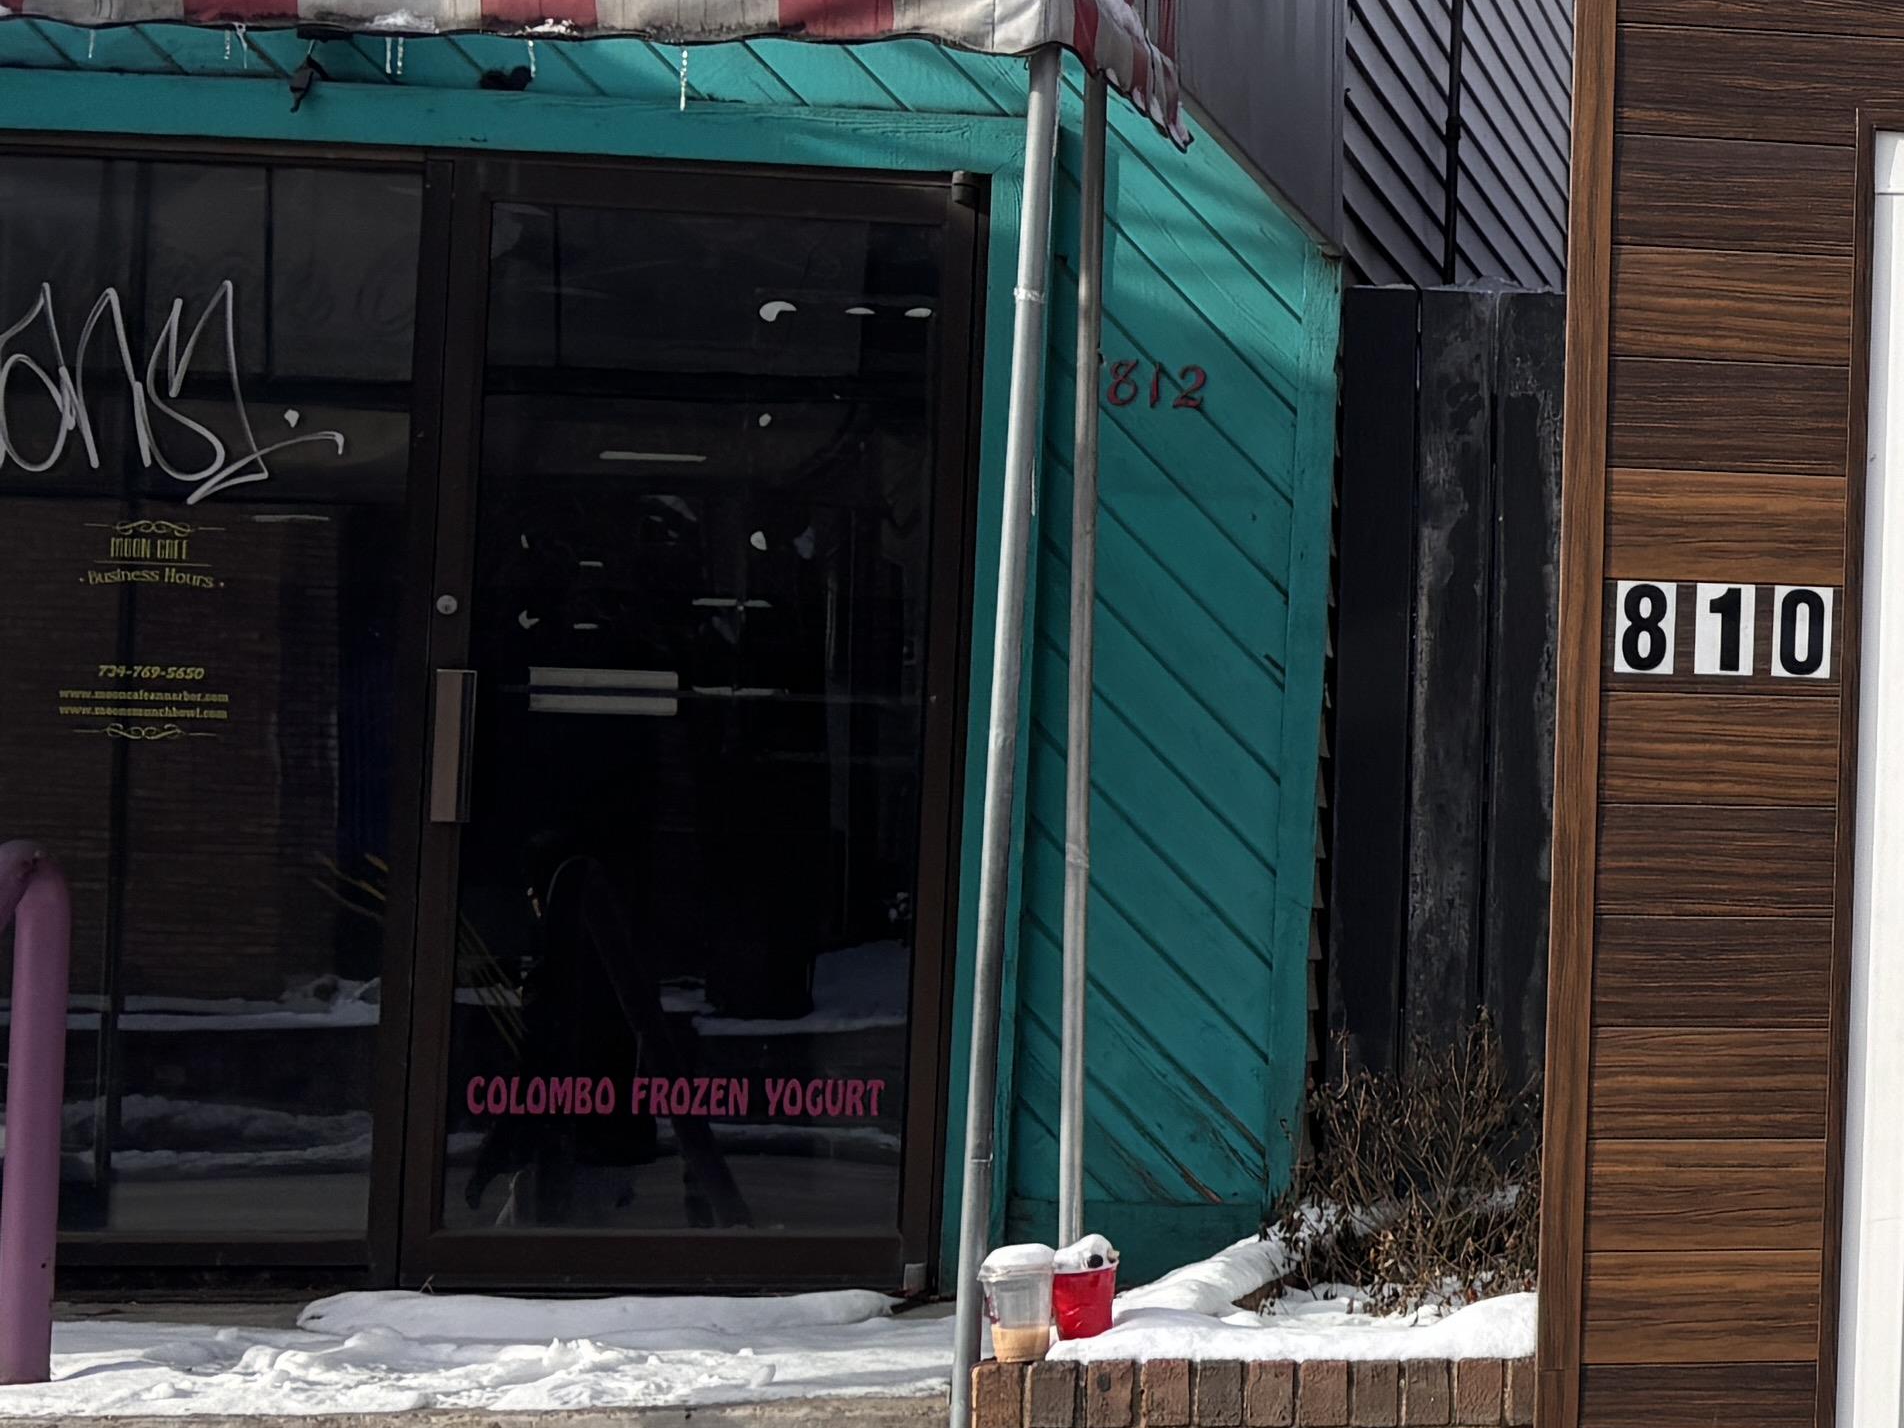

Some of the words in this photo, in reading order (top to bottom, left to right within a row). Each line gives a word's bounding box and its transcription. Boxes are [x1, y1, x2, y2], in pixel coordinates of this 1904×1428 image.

[1106, 359, 1207, 410] 812
[110, 537, 151, 559] MOON
[87, 568, 160, 585] Business
[164, 567, 215, 588] Hours
[1621, 583, 1825, 676] 810
[97, 664, 205, 680] 734-769-5650
[466, 1075, 615, 1116] COLOMBO
[630, 1076, 749, 1118] FROZEN
[765, 1078, 885, 1118] YOGURT
